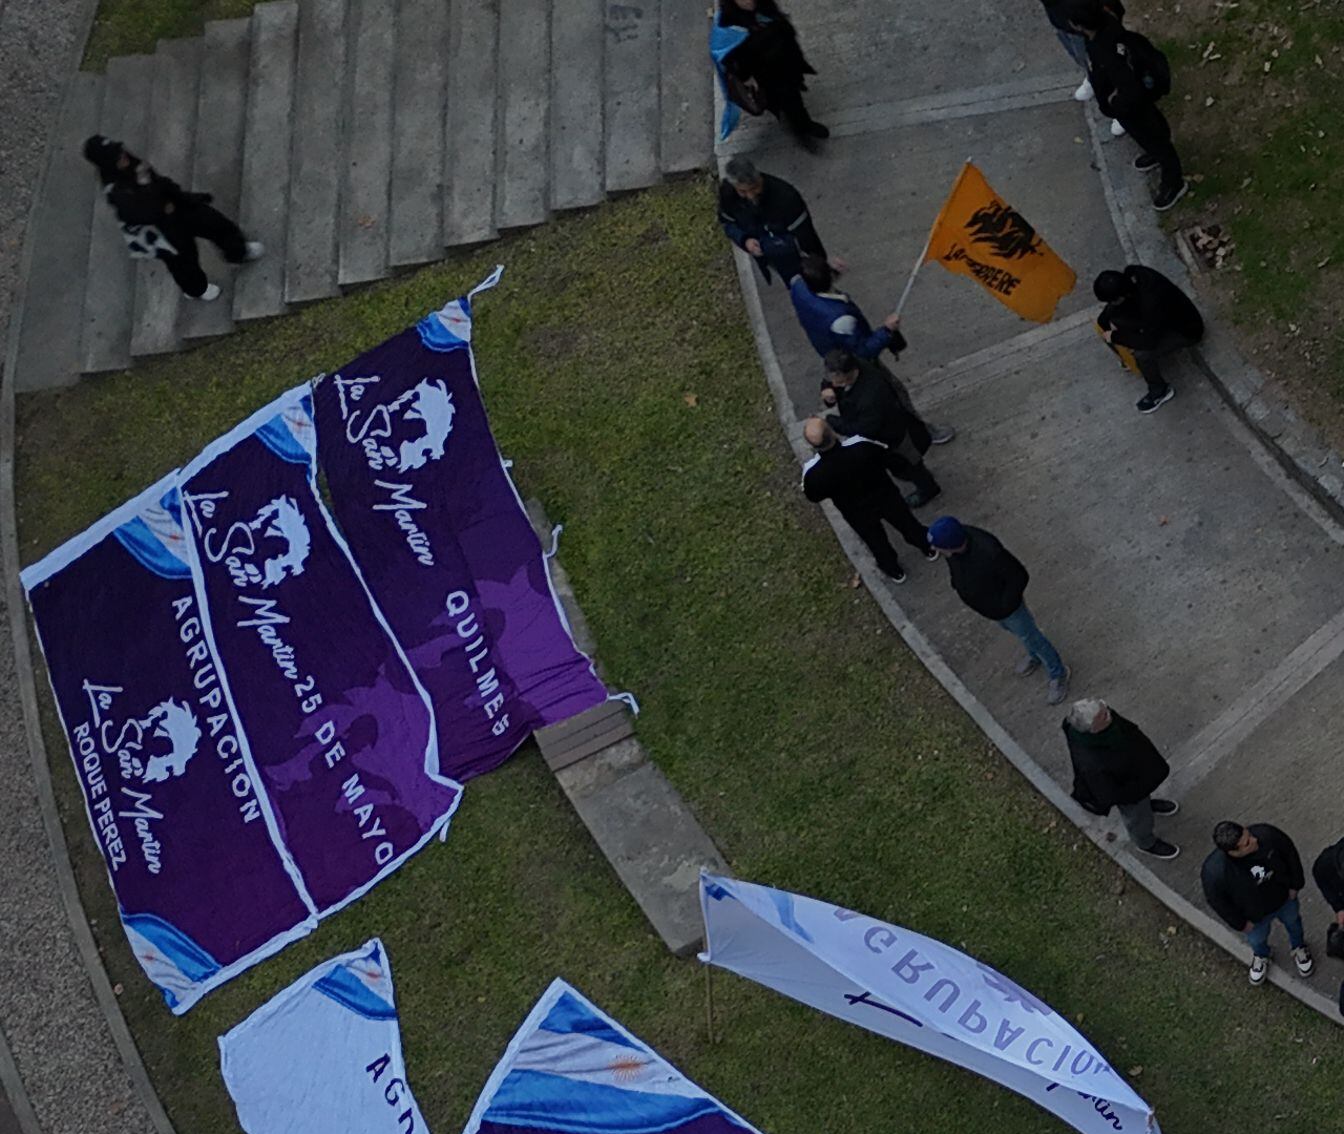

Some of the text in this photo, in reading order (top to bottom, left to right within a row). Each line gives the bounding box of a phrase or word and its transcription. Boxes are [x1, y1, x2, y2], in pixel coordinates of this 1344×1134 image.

[334, 373, 381, 420] La
[183, 489, 230, 540] La
[372, 478, 436, 567] Martin
[82, 678, 124, 729] La
[117, 785, 165, 876] Martin
[236, 594, 395, 867] Martin 25 DE MAYO
[72, 719, 128, 873] ROQUE PEREZ
